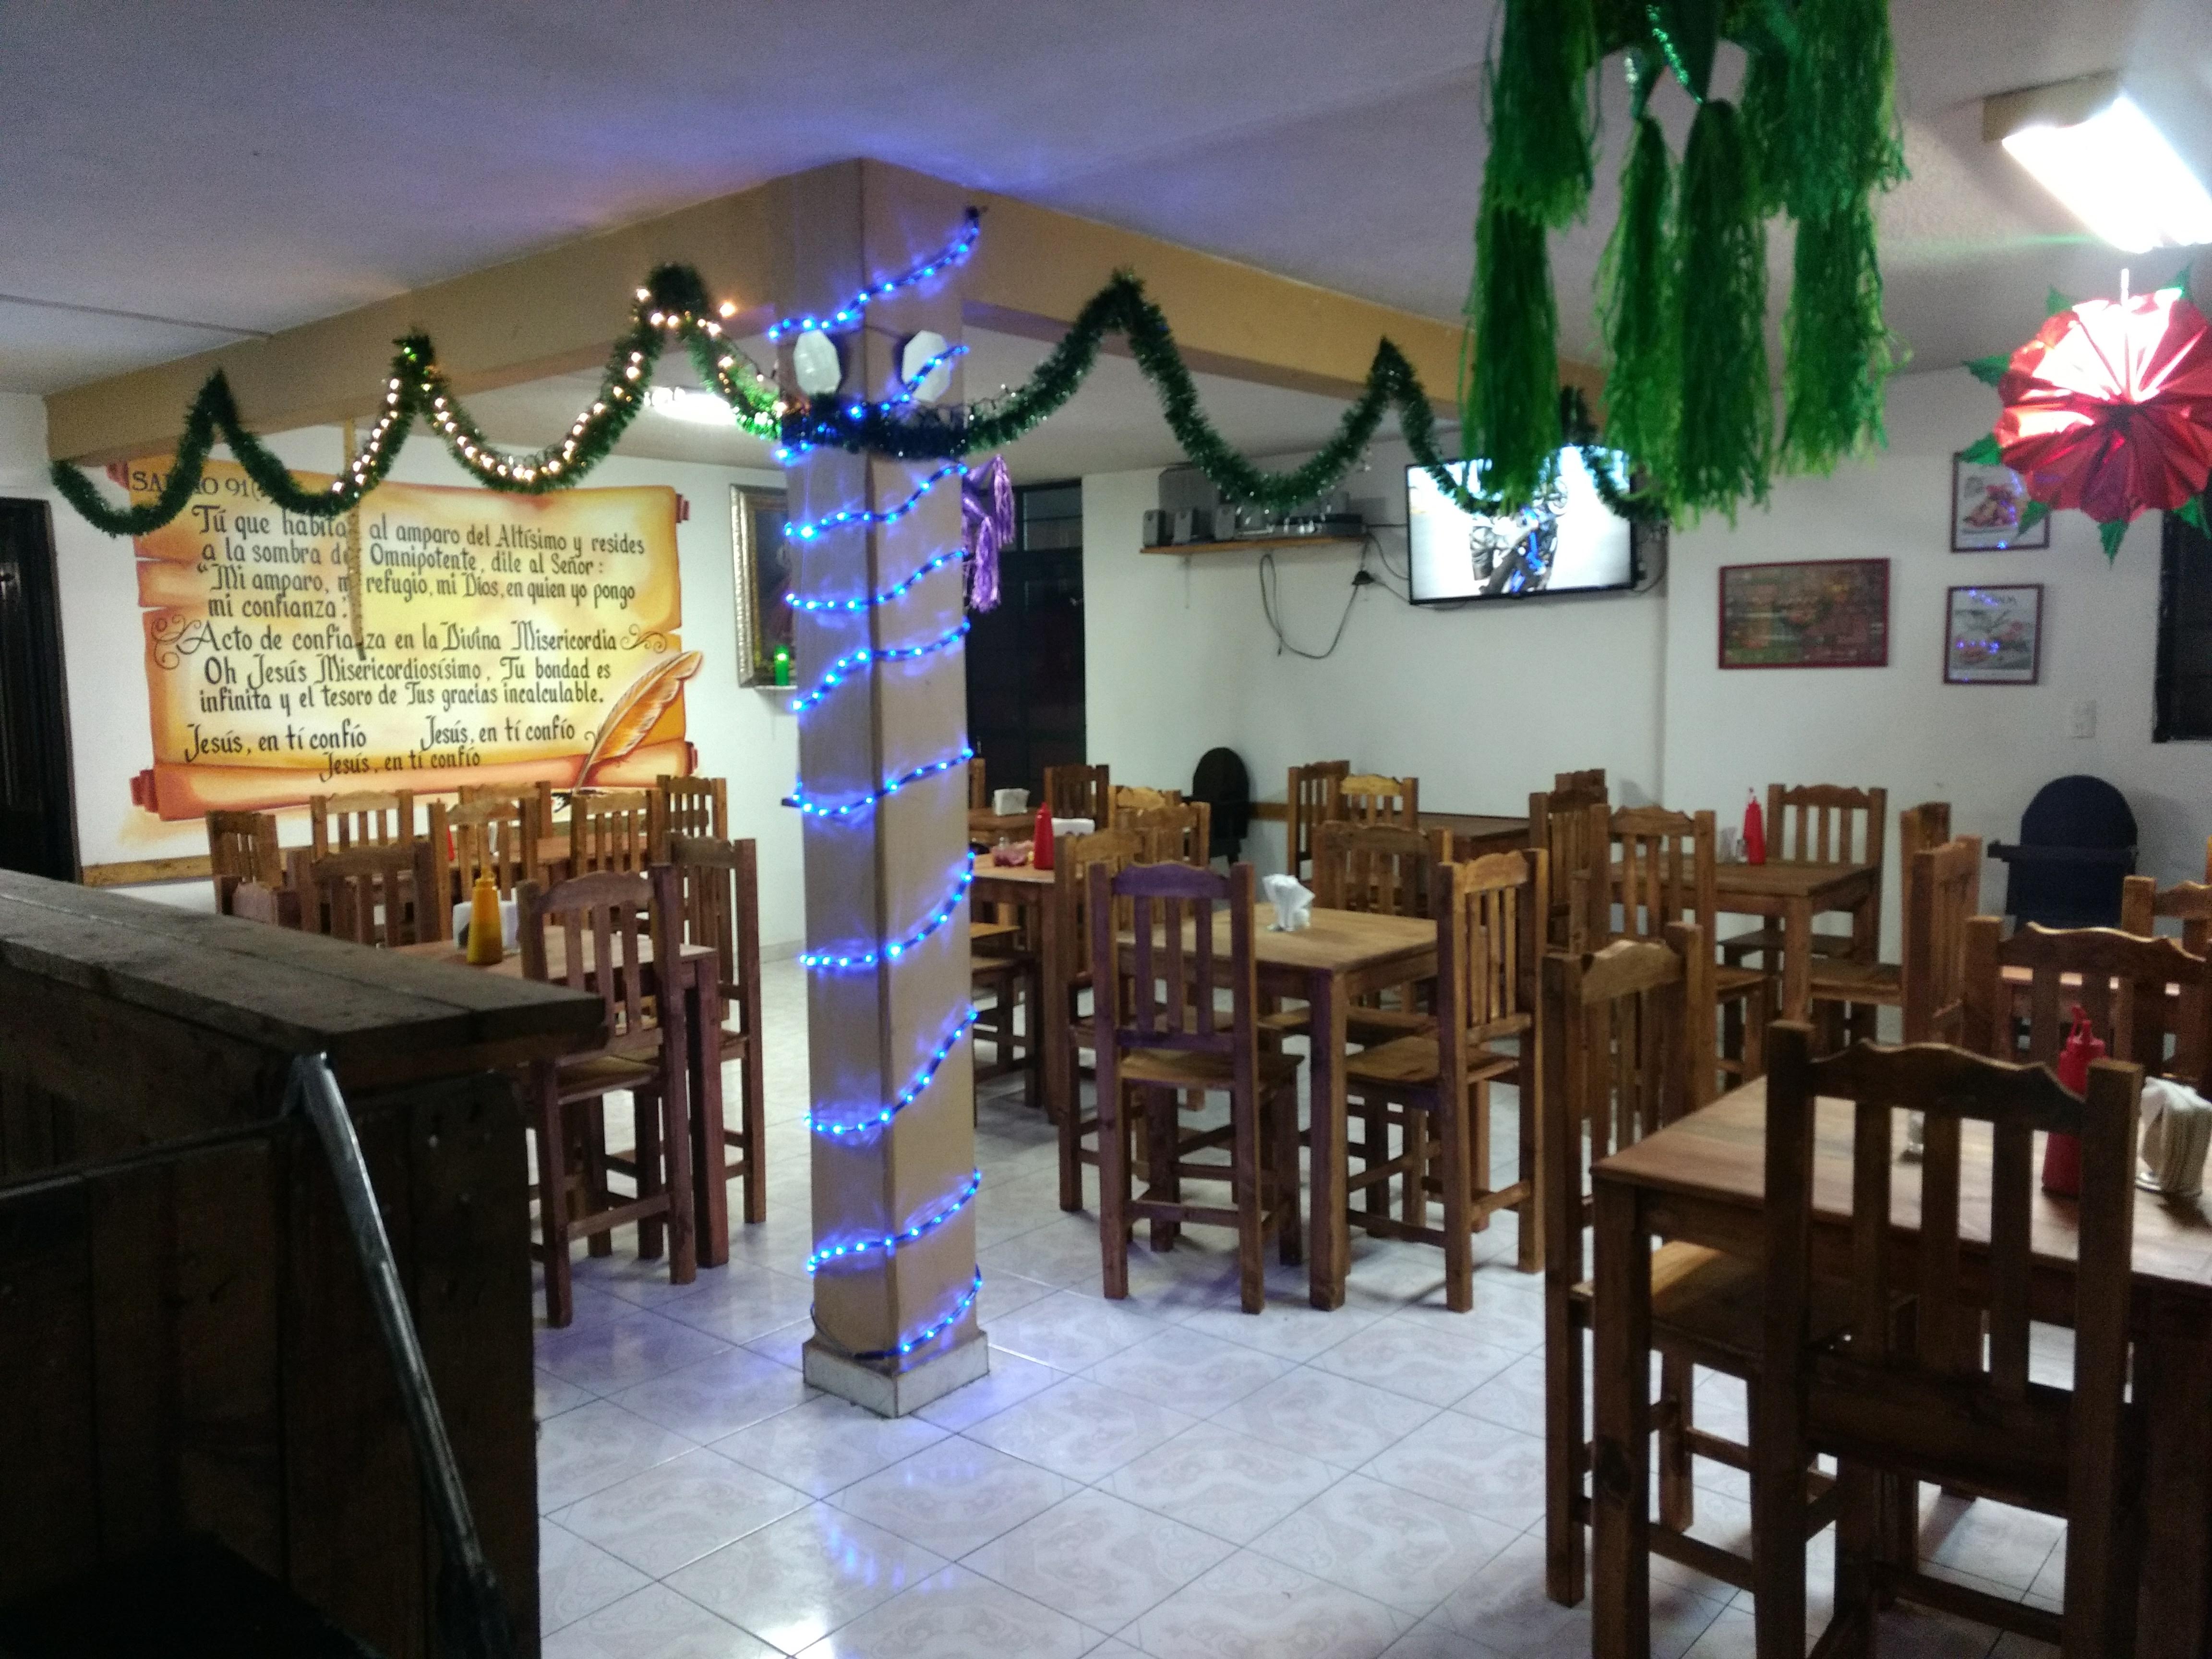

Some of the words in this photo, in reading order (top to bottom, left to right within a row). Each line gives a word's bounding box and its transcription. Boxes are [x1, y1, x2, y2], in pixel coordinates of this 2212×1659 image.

[132, 470, 219, 495] SAO
[192, 504, 227, 534] Tú
[234, 515, 271, 540] que
[369, 512, 387, 541] al
[396, 525, 460, 550] amparo
[466, 523, 490, 546] del
[495, 523, 567, 551] Altísimo
[573, 535, 582, 558] y
[591, 532, 645, 554] resides
[202, 543, 216, 561] a
[226, 536, 245, 562] la
[252, 538, 322, 565] sombra
[491, 550, 521, 573] dile
[529, 552, 544, 573] al
[207, 593, 233, 617] mi
[252, 573, 329, 598] amparo,
[437, 572, 457, 595] mi
[506, 581, 524, 597] en
[527, 576, 566, 605] quien
[570, 582, 587, 607] yo
[593, 583, 636, 610] pongo
[175, 620, 252, 655] Acto
[260, 624, 282, 650] de
[292, 624, 386, 650] confiaza
[395, 632, 414, 649] en
[421, 622, 438, 649] la
[440, 621, 501, 652] Divina
[510, 619, 617, 651] Misericordia
[204, 656, 237, 685] Oh
[247, 653, 307, 690] Jesús
[499, 655, 526, 683] Tu
[535, 655, 590, 679] bondad
[597, 663, 612, 679] es
[199, 686, 272, 713] infinita
[279, 693, 291, 717] y
[299, 684, 315, 708] el
[320, 684, 373, 707] tesoro
[378, 682, 397, 705] de
[404, 680, 435, 707] Tus
[441, 682, 498, 712] gracias
[504, 680, 604, 704] incalculable.
[184, 723, 252, 763] Jesús,
[258, 734, 280, 752] en
[309, 718, 367, 749] confío
[419, 714, 474, 752] Jesús,
[479, 726, 497, 742] en
[526, 714, 575, 741] confío
[385, 756, 403, 771] en
[430, 745, 481, 768] confío
